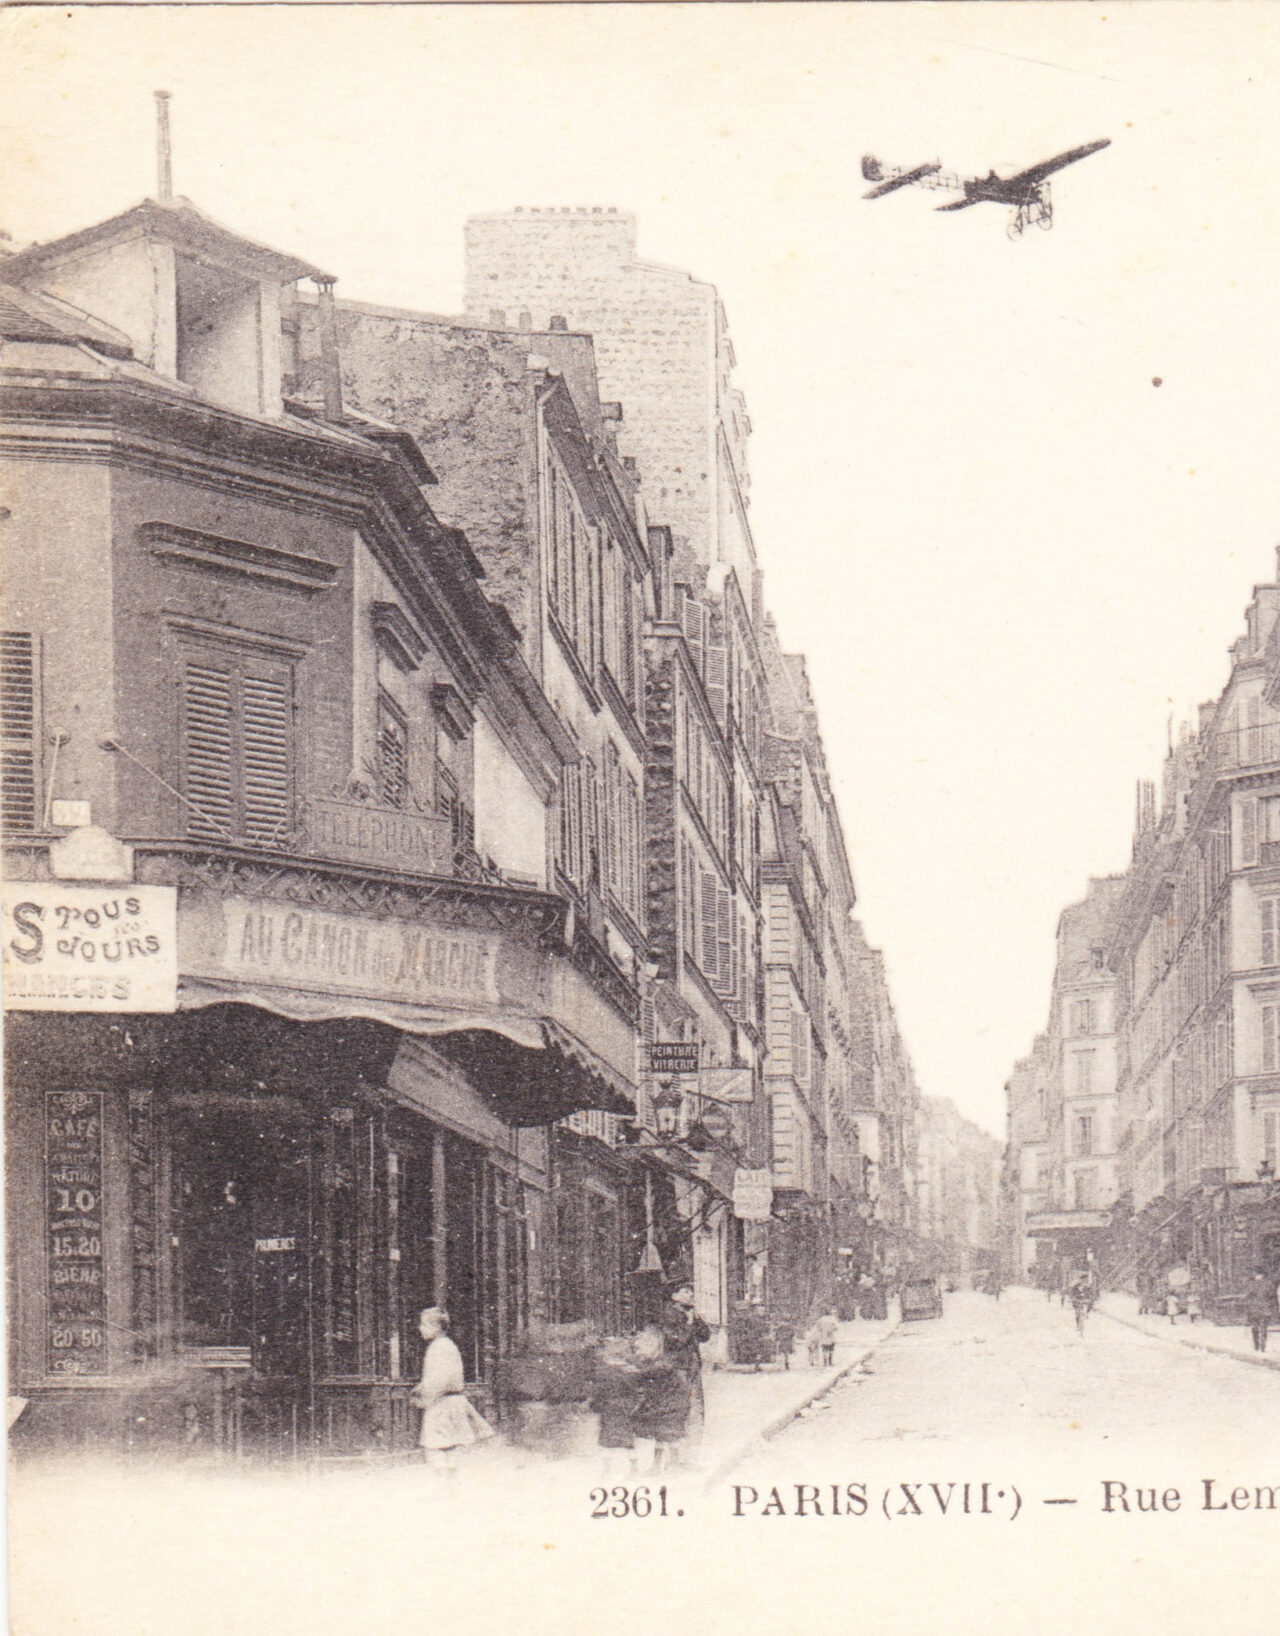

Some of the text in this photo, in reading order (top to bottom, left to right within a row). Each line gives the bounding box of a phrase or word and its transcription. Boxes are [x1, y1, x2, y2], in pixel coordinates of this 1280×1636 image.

[55, 897, 141, 931] TOUS
[56, 934, 161, 963] JOURS
[240, 912, 273, 966] AU
[56, 1189, 95, 1213] 10
